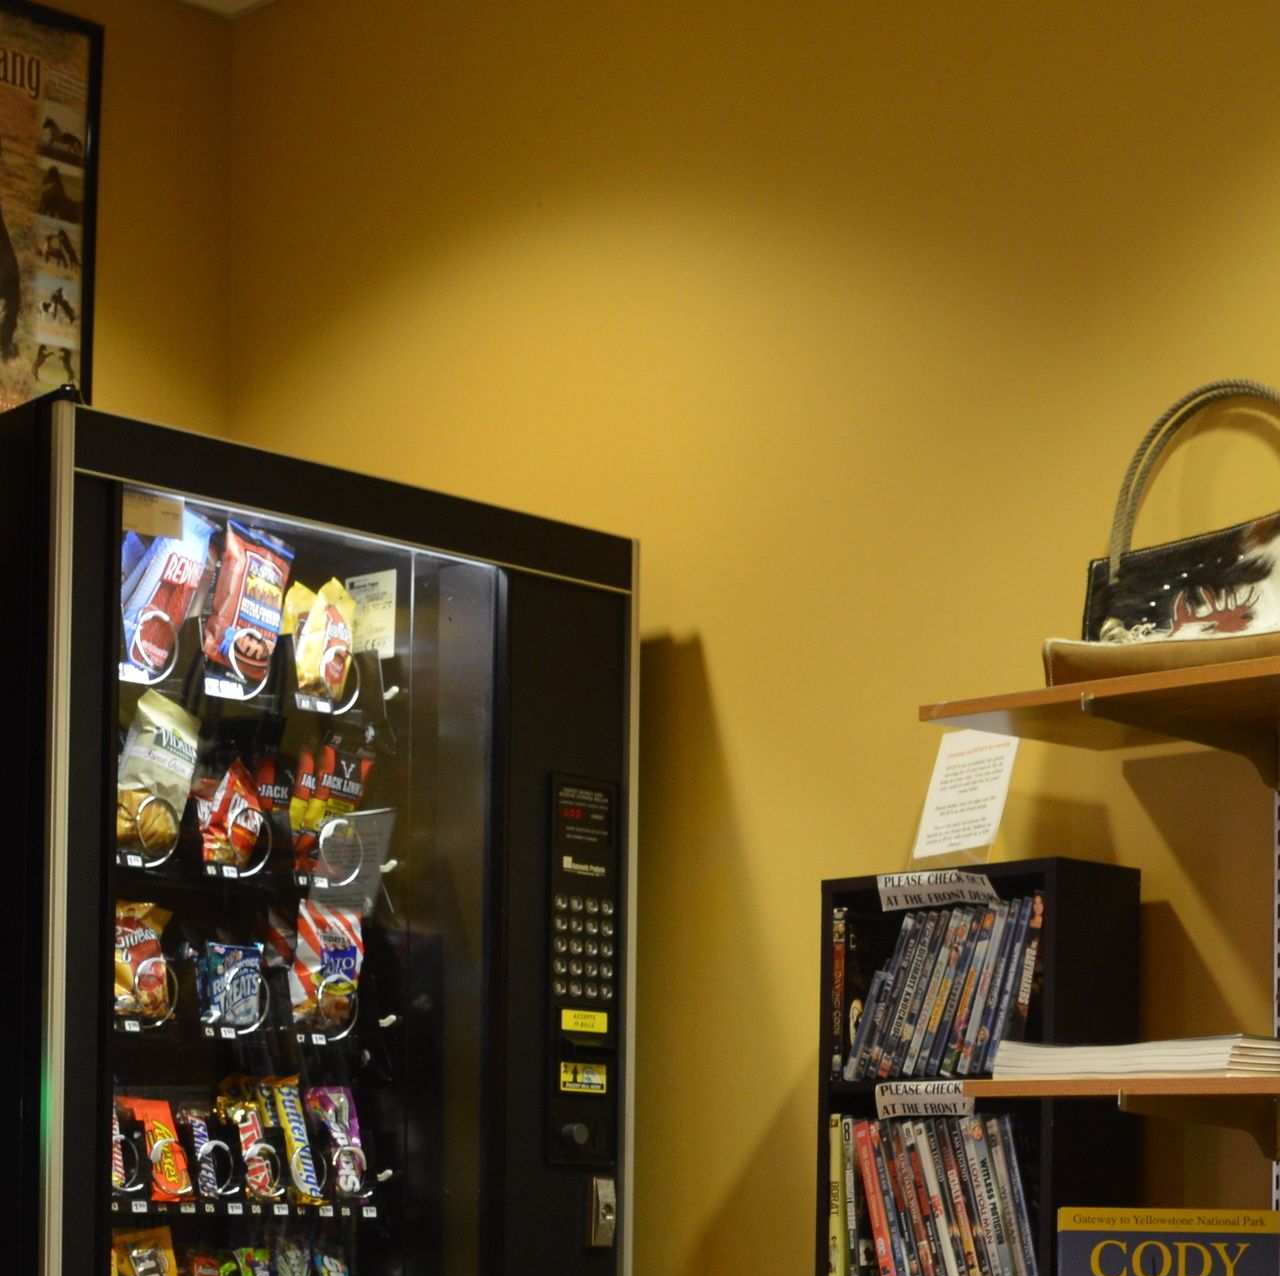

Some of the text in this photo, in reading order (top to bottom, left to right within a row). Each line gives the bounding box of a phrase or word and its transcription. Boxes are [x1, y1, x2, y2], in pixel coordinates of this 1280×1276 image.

[321, 774, 344, 791] JACK
[260, 785, 289, 799] JACK
[884, 873, 925, 888] PLEASE
[927, 872, 965, 886] CHECK
[886, 889, 967, 908] AT THE FRONT
[880, 1081, 962, 1097] PLEASE CHECK
[882, 1103, 959, 1117] AT THE FRONT
[843, 1122, 851, 1142] 8
[830, 1180, 840, 1217] BORAT
[980, 1157, 1005, 1246] WITLESS PROTECTION
[1072, 1214, 1267, 1228] Gateway to Yellowstone National Park
[980, 1217, 994, 1246] MAN
